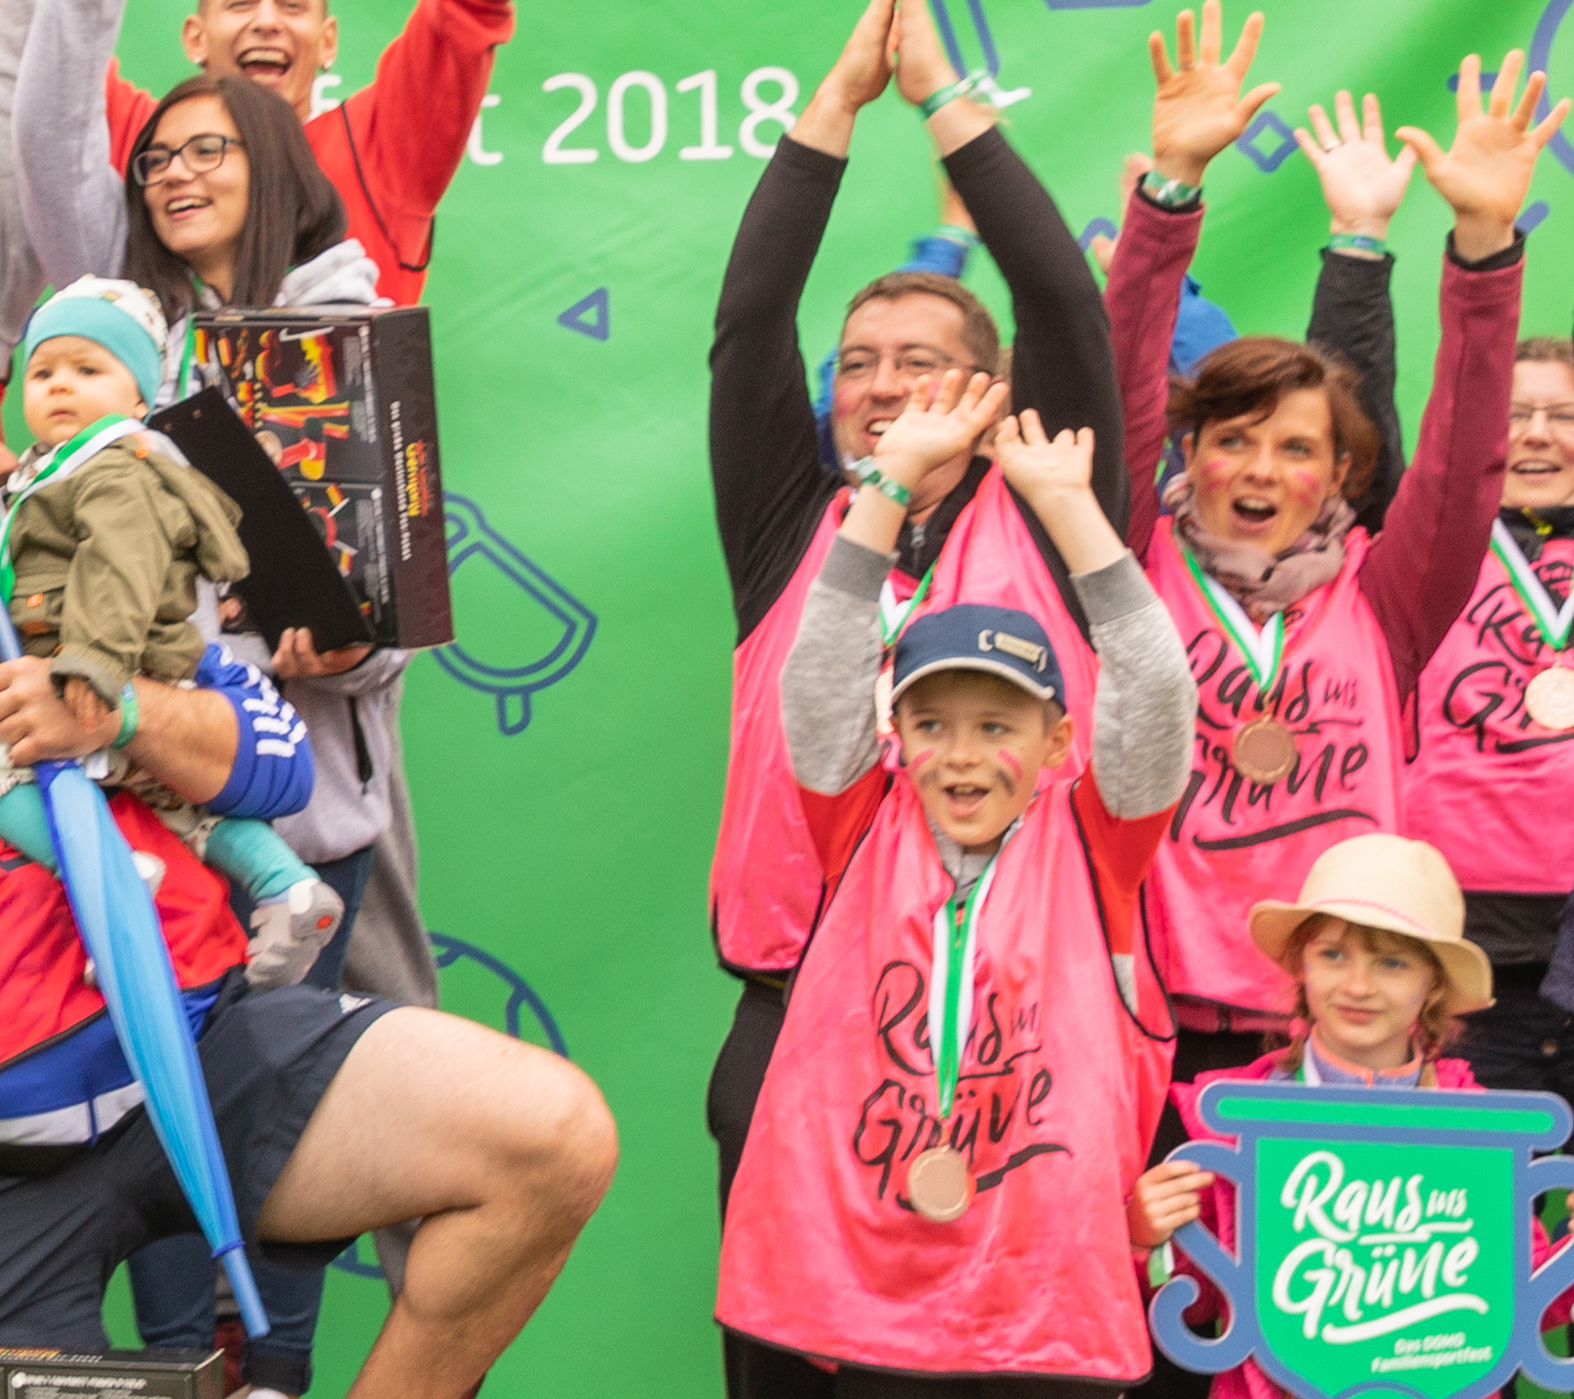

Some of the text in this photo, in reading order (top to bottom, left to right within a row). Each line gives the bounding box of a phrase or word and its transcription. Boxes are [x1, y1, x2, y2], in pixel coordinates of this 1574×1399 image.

[540, 66, 801, 164] 2018
[1279, 1149, 1469, 1243] Raus ins
[1271, 1236, 1480, 1340] Grüne
